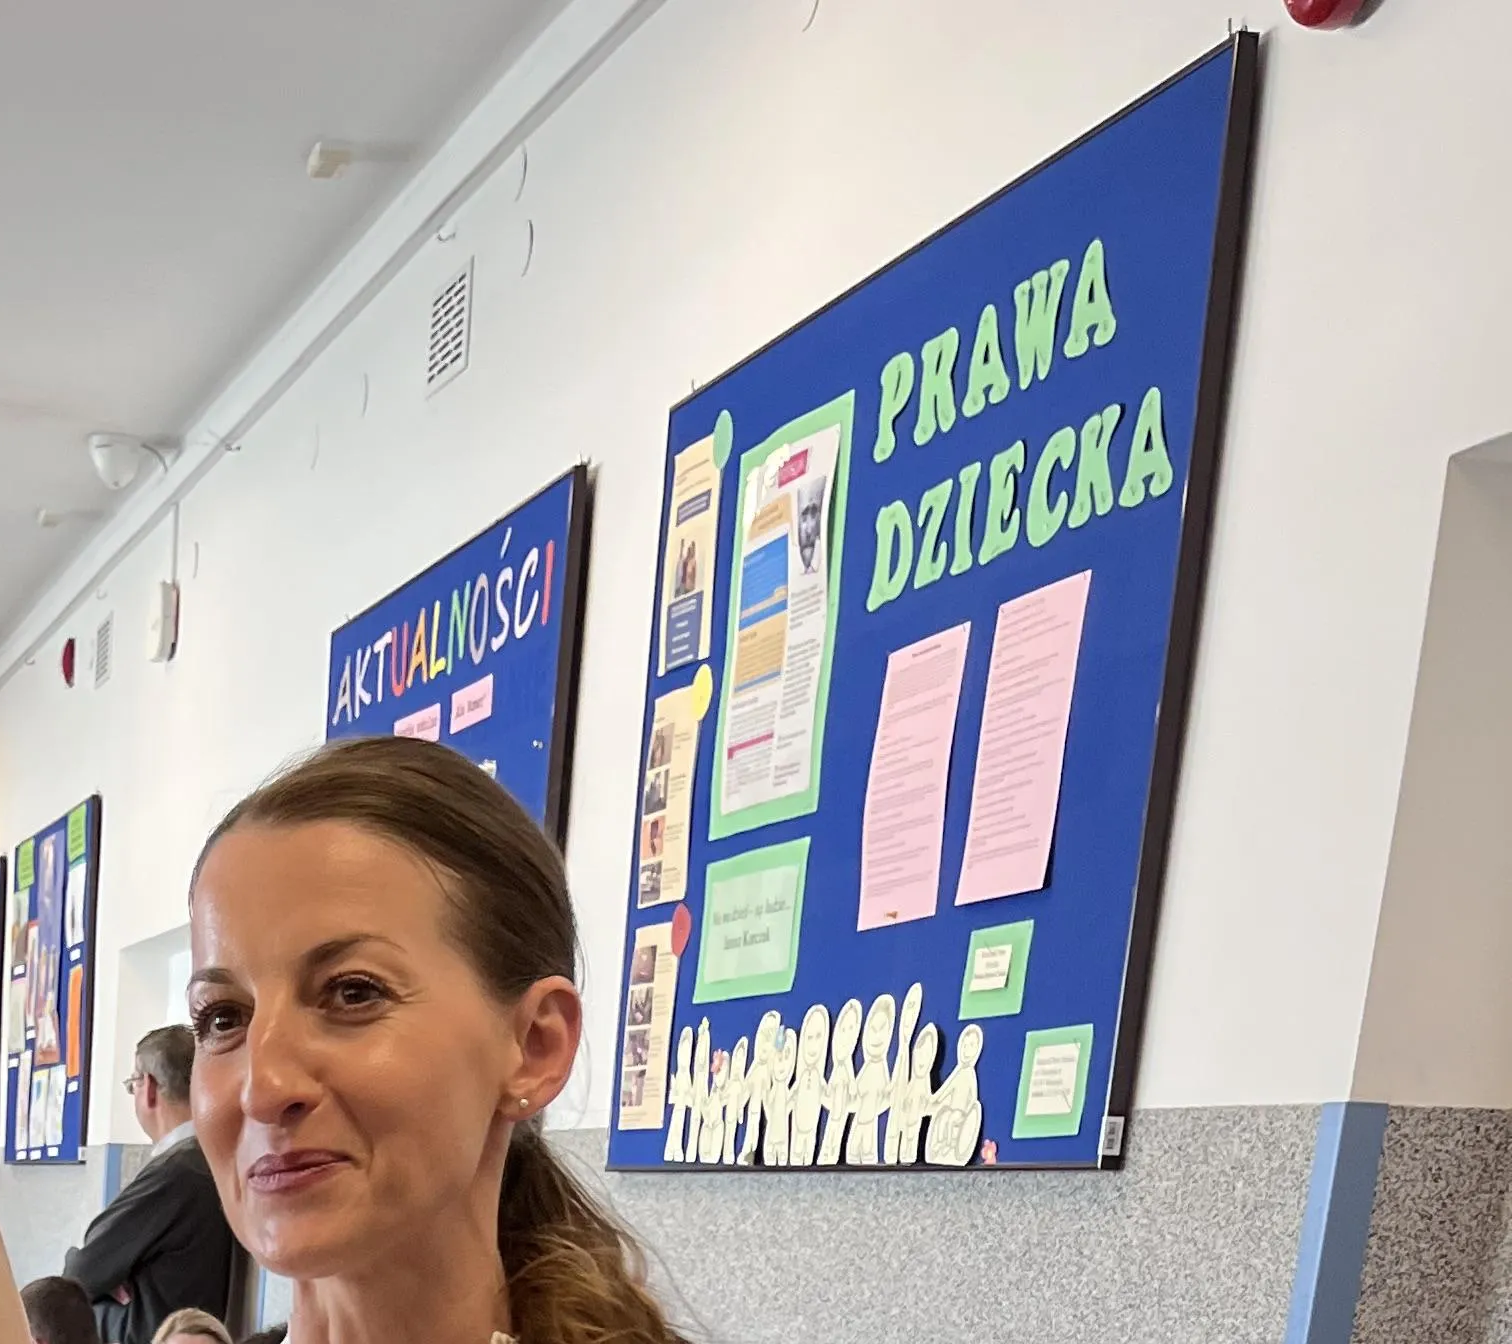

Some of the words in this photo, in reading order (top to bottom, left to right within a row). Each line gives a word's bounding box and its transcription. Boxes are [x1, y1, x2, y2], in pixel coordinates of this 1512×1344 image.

[873, 239, 1117, 463] PRAWA
[866, 386, 1174, 613] DZIECKA
[332, 526, 555, 726] AKTUALNOŚCI
